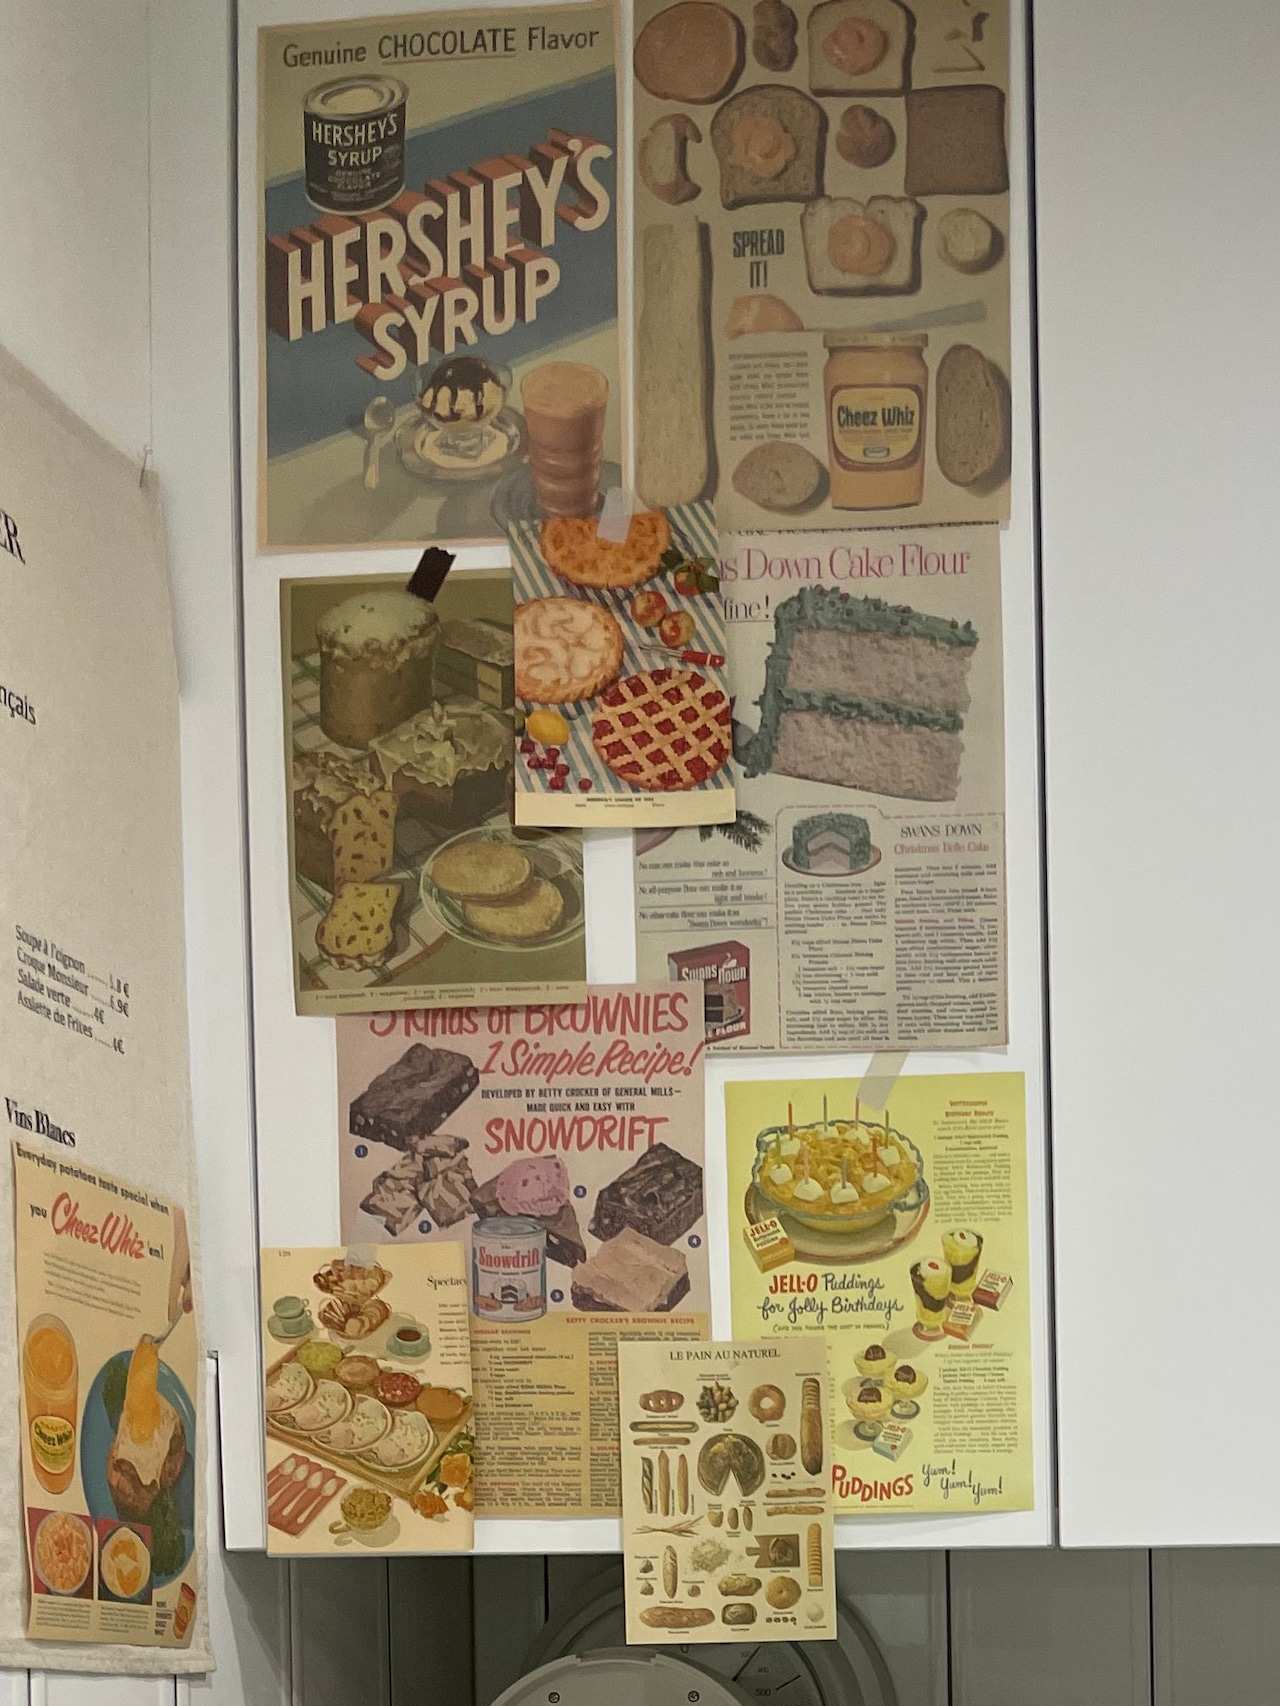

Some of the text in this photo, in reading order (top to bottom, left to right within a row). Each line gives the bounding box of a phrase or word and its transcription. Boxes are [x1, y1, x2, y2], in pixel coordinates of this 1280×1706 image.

[283, 26, 600, 69] Genuine CHOCOLATE Flavor
[312, 113, 398, 147] HERSHEY'S
[327, 145, 383, 167] SYRUP
[286, 136, 613, 342] HERSHEY'S
[732, 229, 785, 258] SPREAD
[749, 260, 768, 289] IT!
[371, 255, 561, 381] SYRUP
[837, 404, 915, 428] Cheez Whiz
[742, 548, 824, 580] Down
[828, 547, 894, 580] Cake
[898, 543, 970, 577] Flour
[900, 823, 982, 838] SWANS DOWN
[47, 962, 89, 997] Monsieur
[45, 985, 71, 1008] verte
[53, 1007, 66, 1026] de
[524, 991, 689, 1036] BROWNIES
[479, 1038, 706, 1084] 1 Simple Recipe!
[481, 1088, 522, 1100] DEVELOPED
[525, 1088, 536, 1099] BY
[538, 1087, 562, 1098] BETTY
[565, 1087, 599, 1098] CROCKER
[602, 1086, 611, 1097] OF
[614, 1086, 647, 1097] GENERAL
[526, 1101, 636, 1113] MADE QUICK AND EASY WITH
[5, 1096, 76, 1148] Vins Blancs
[484, 1113, 670, 1155] SNOWDRIFT
[15, 1141, 170, 1216] Everyday potatoes taste special when
[29, 1203, 48, 1219] you
[50, 1191, 99, 1245] Cheez
[100, 1211, 146, 1260] Whiz
[478, 1245, 541, 1269] Snowdrift
[821, 1272, 885, 1299] Puddings
[756, 1295, 905, 1324] for Jolly Birthdays
[669, 1348, 781, 1361] LE PAIN AU NATUREL
[831, 1464, 914, 1503] PUDDINGS
[922, 1458, 956, 1488] Yum!
[940, 1470, 973, 1500] Yum!
[972, 1475, 1003, 1506] Yum!
[755, 1688, 772, 1697] 500
